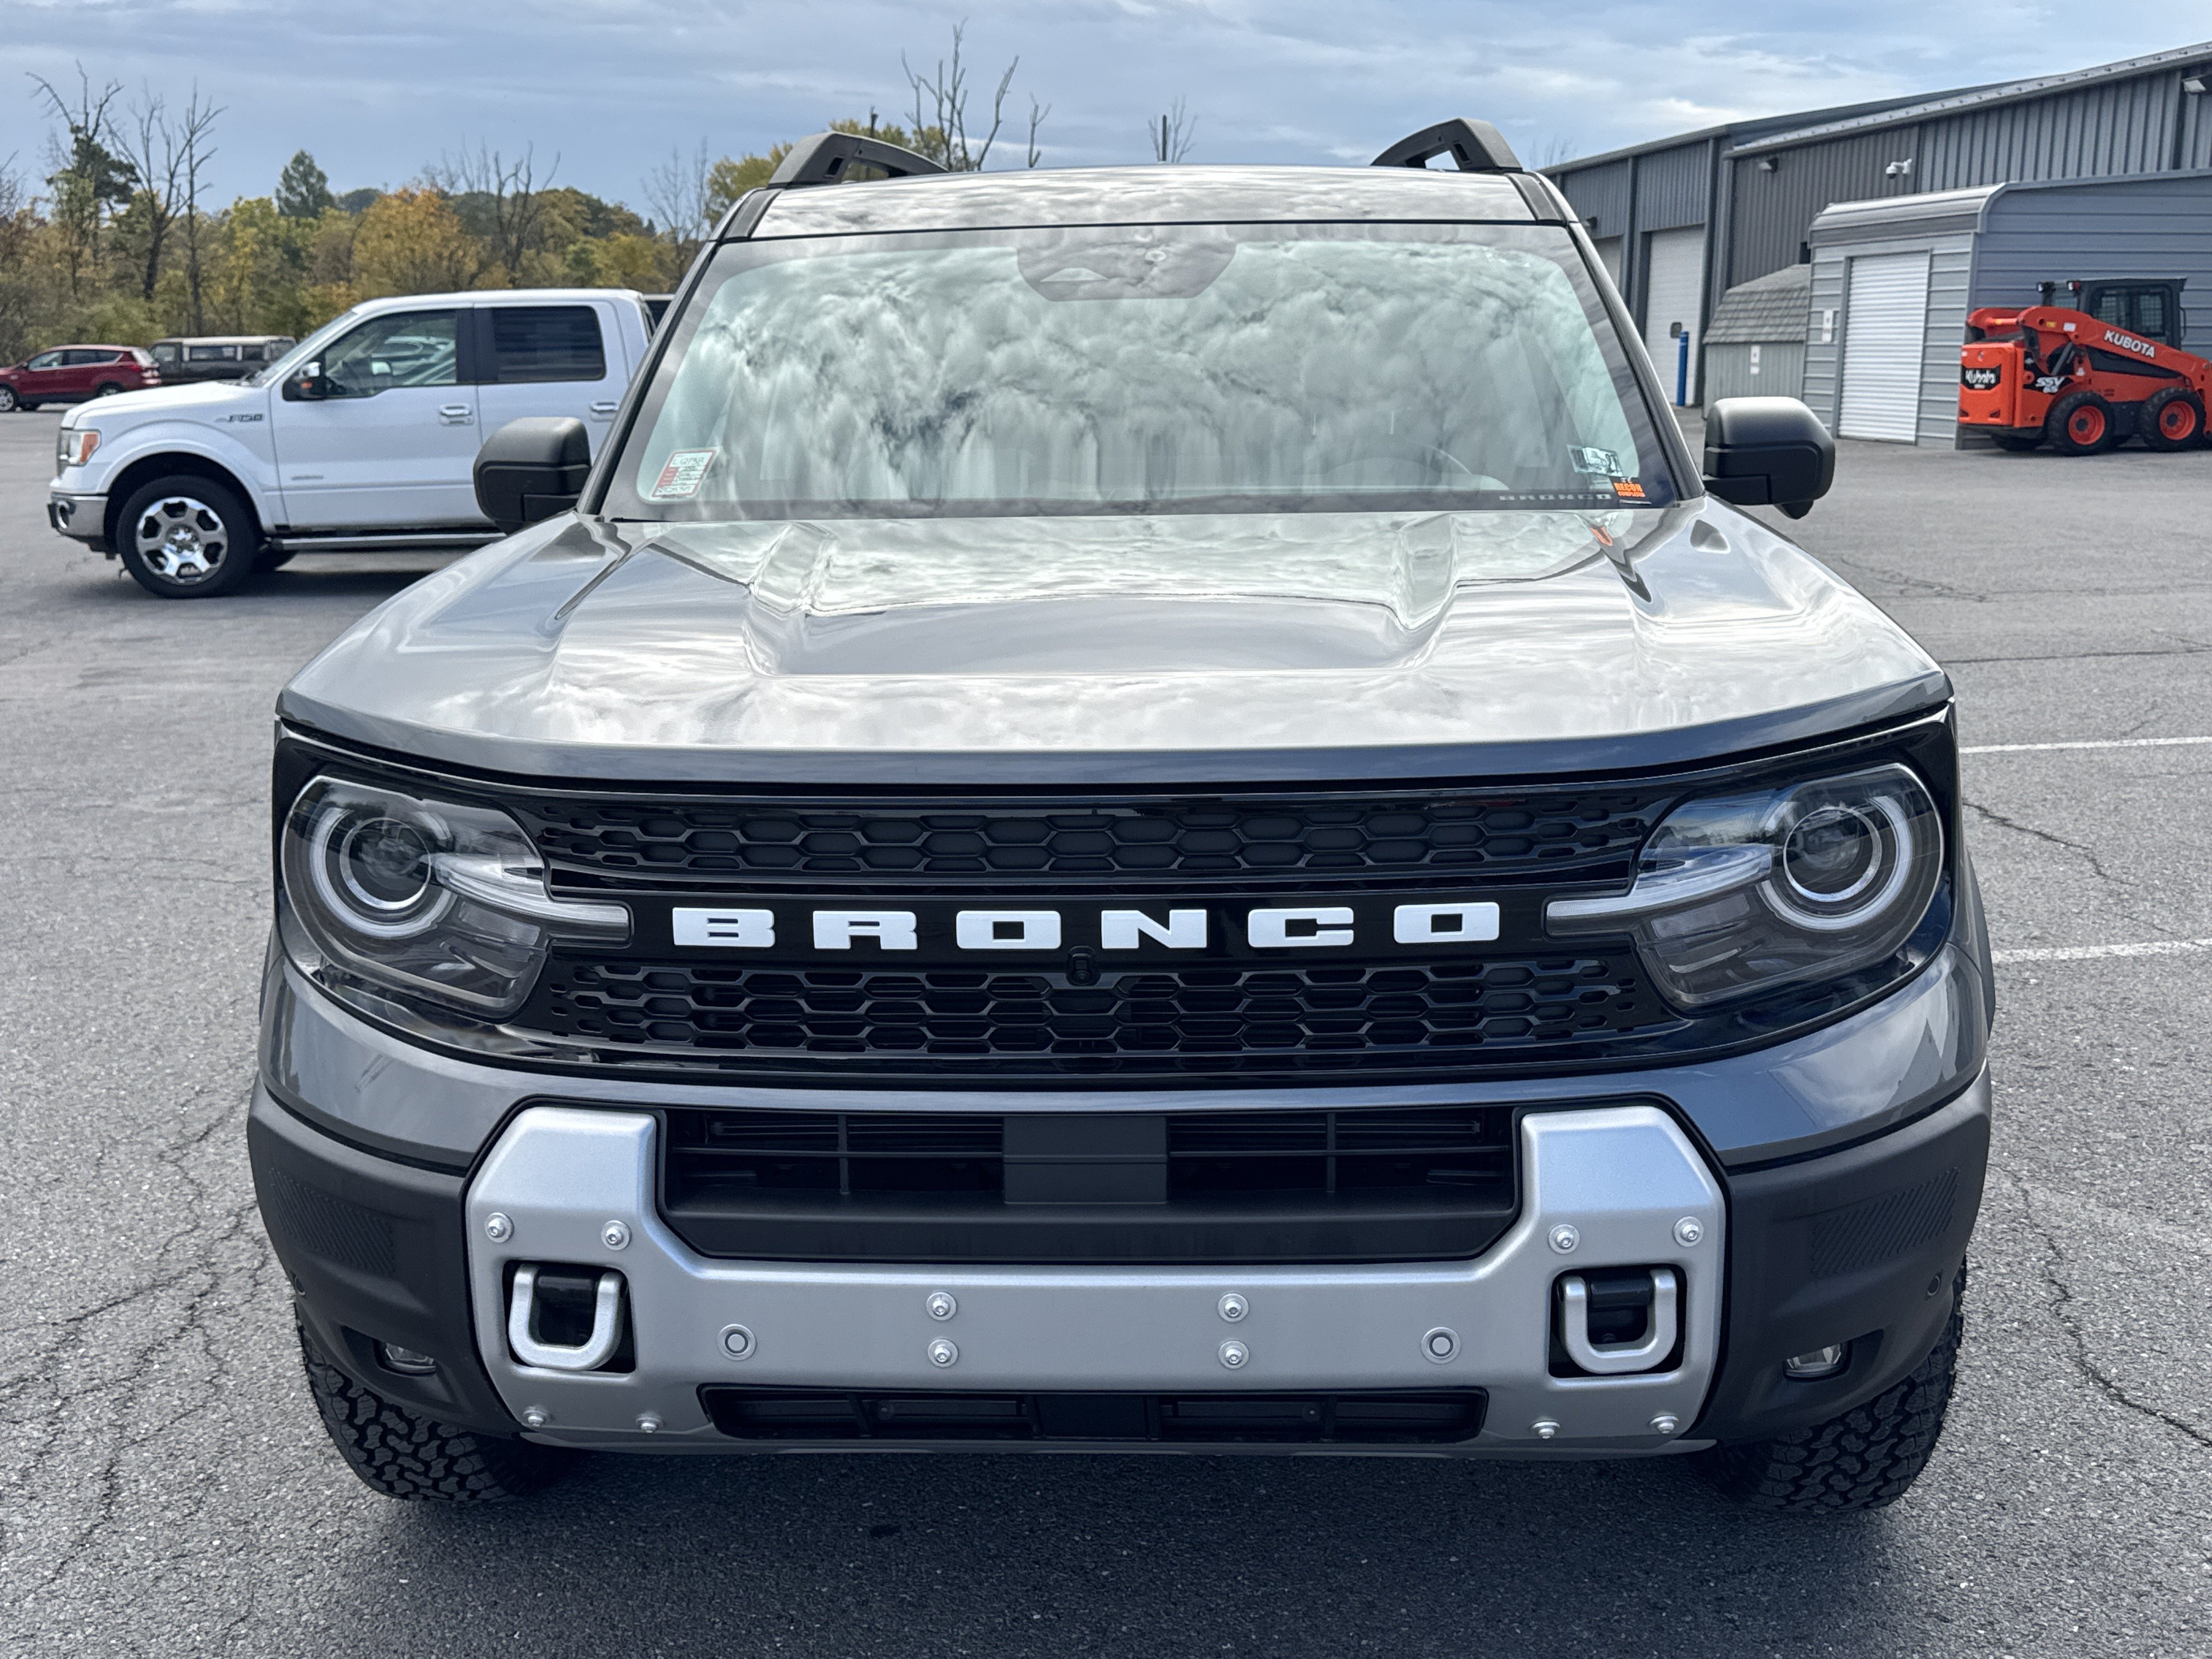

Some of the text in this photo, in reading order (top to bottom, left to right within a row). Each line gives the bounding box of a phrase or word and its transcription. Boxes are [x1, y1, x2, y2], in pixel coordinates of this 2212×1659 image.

[2104, 330, 2155, 358] KUBOTA
[1965, 370, 1996, 384] Kubota
[672, 901, 1500, 950] BRONCO
